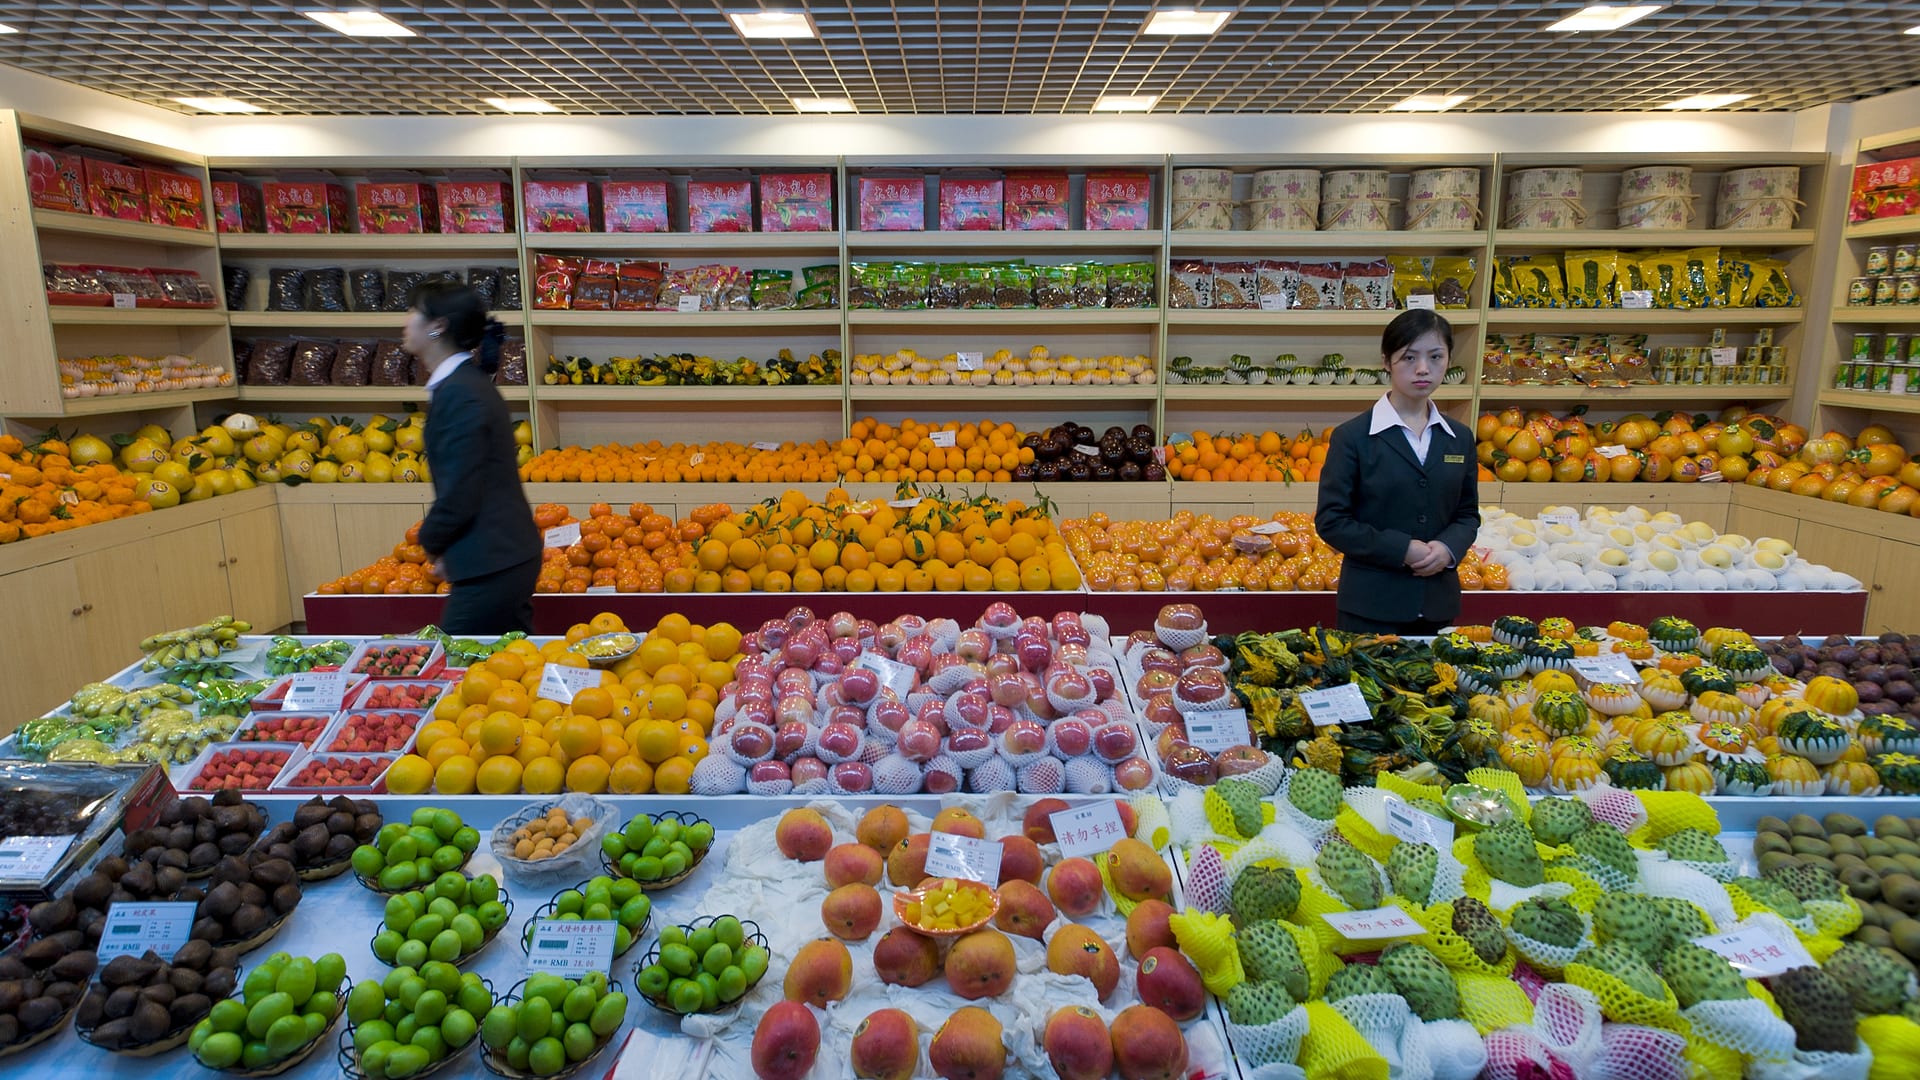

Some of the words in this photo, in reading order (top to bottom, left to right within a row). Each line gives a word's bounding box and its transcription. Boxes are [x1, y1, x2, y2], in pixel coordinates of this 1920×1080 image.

[102, 168, 136, 190] 大礼包
[1868, 165, 1911, 187] 大礼包
[161, 179, 193, 200] 大礼包
[277, 187, 314, 205] 大礼包
[371, 187, 406, 205] 大礼包
[451, 187, 487, 204] 大礼包
[617, 186, 653, 201] 大礼包
[777, 180, 816, 198] 大礼包
[874, 184, 909, 201] 大礼包
[954, 184, 989, 201] 大礼包
[1020, 184, 1056, 200] 大礼包
[1100, 183, 1137, 200] 大礼包
[1195, 277, 1210, 306] 松子
[1240, 276, 1255, 301] 松子
[1321, 282, 1337, 306] 松子
[1366, 280, 1382, 307] 松子
[1062, 820, 1120, 846] 请勿手捏
[1340, 917, 1409, 932] 请勿手捏
[550, 959, 568, 967] RMB
[1726, 944, 1784, 964] 勿手捏
